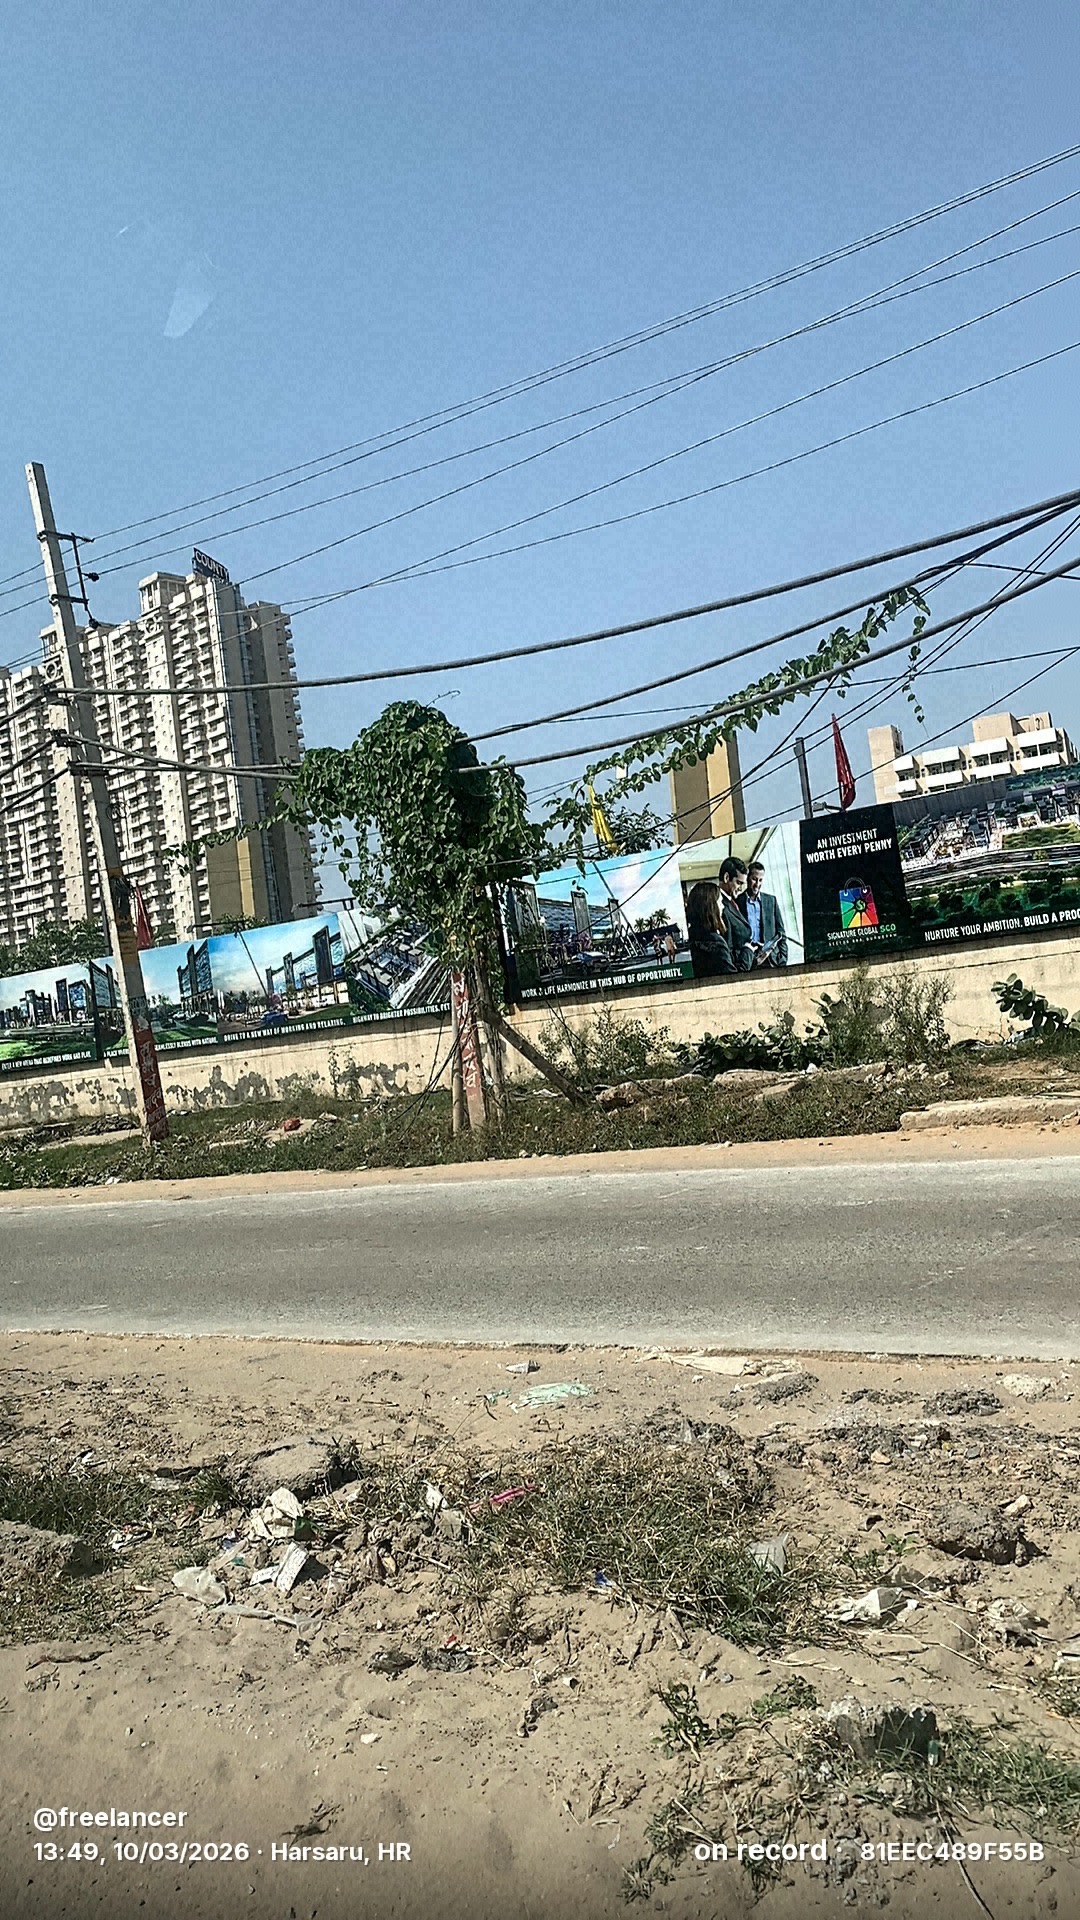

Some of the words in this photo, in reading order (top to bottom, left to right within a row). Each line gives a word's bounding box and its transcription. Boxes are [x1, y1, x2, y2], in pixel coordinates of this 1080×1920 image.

[817, 838, 827, 849] AN
[829, 828, 878, 847] INVESTMENT
[806, 848, 836, 864] WORTH
[837, 844, 862, 858] EVERY
[864, 838, 892, 853] PENNY
[827, 928, 857, 941] SIGNATURE
[857, 926, 879, 936] GLOBAL
[880, 923, 897, 933] SCO
[924, 926, 960, 942] NURTURE
[960, 923, 982, 936] YOUR
[983, 917, 1023, 933] AMBITION.
[1023, 913, 1050, 927] BUILD
[1051, 912, 1059, 923] A
[521, 987, 538, 998] WORK
[544, 985, 555, 996] LIFE
[556, 980, 589, 993] HARMONIZE
[589, 979, 597, 989] IN
[598, 976, 613, 988] THIS
[613, 974, 627, 985] HUB
[627, 973, 636, 983] OF
[636, 967, 683, 982] OPPORTUNITY.
[373, 1013, 380, 1021] TO
[223, 1032, 239, 1042] DRIVE
[239, 1032, 246, 1040] TO
[251, 1029, 262, 1039] NEW
[262, 1028, 273, 1037] WAY
[273, 1027, 281, 1035] OF
[281, 1023, 305, 1034] WORKING
[305, 1021, 317, 1030] AND
